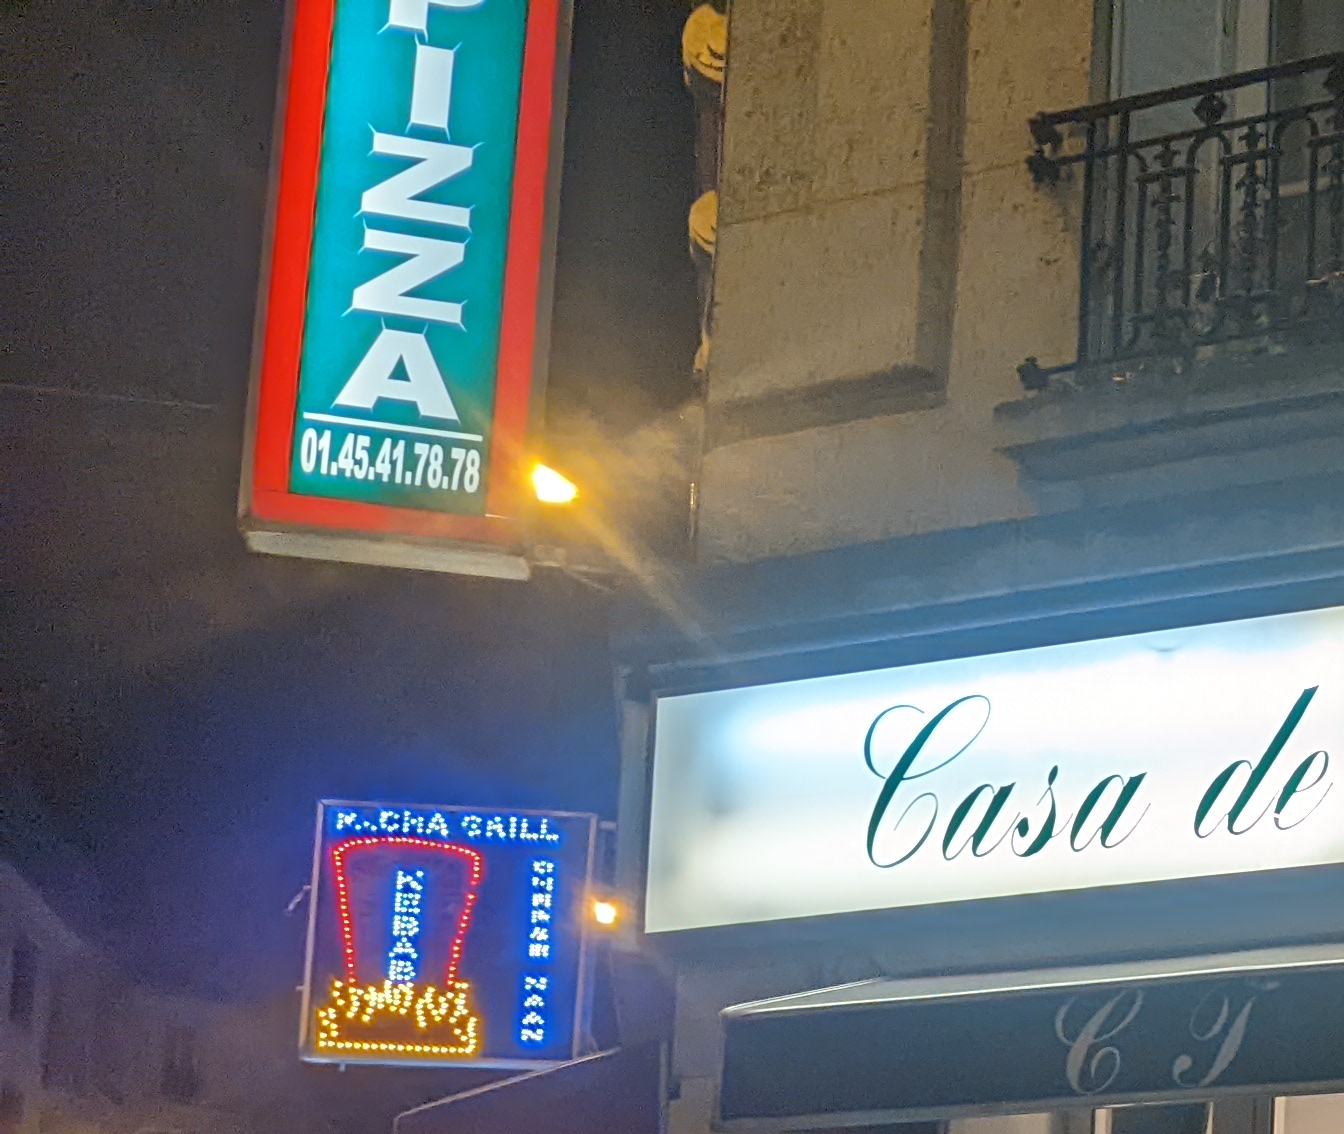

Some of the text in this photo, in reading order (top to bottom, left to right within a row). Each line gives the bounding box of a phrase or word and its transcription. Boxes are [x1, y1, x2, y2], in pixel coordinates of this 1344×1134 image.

[301, 428, 480, 493] 01.45.41.78.78
[864, 694, 1150, 868] Casa
[1194, 685, 1333, 838] de
[388, 870, 424, 981] KEBAB
